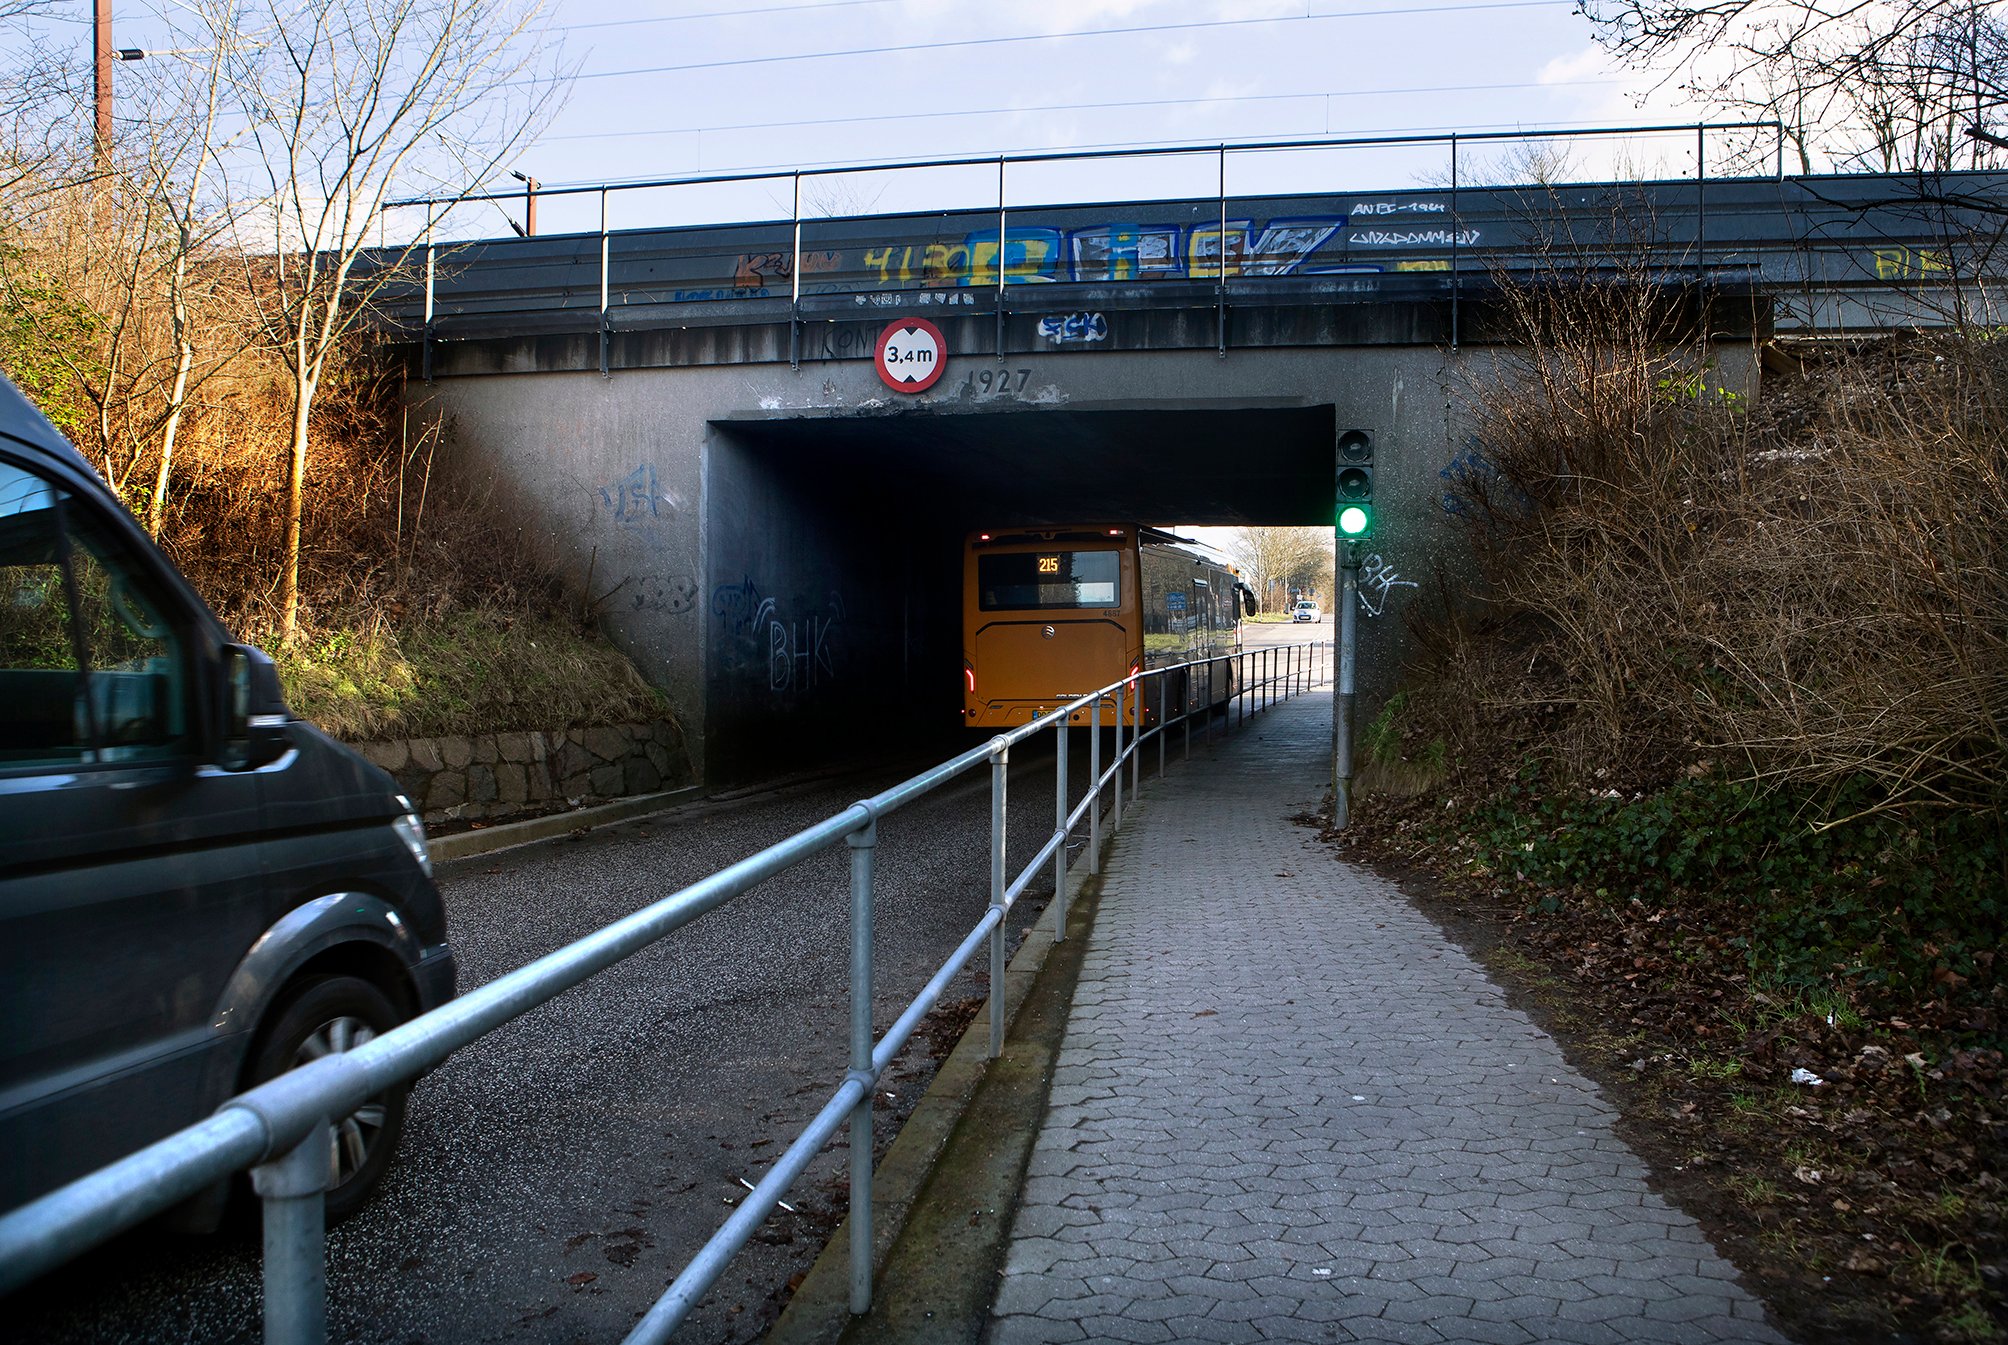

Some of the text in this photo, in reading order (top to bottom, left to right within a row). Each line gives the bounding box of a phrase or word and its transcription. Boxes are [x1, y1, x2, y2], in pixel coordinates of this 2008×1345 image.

[967, 368, 1032, 394] 1927
[1039, 557, 1059, 572] 215
[769, 615, 835, 692] BHK
